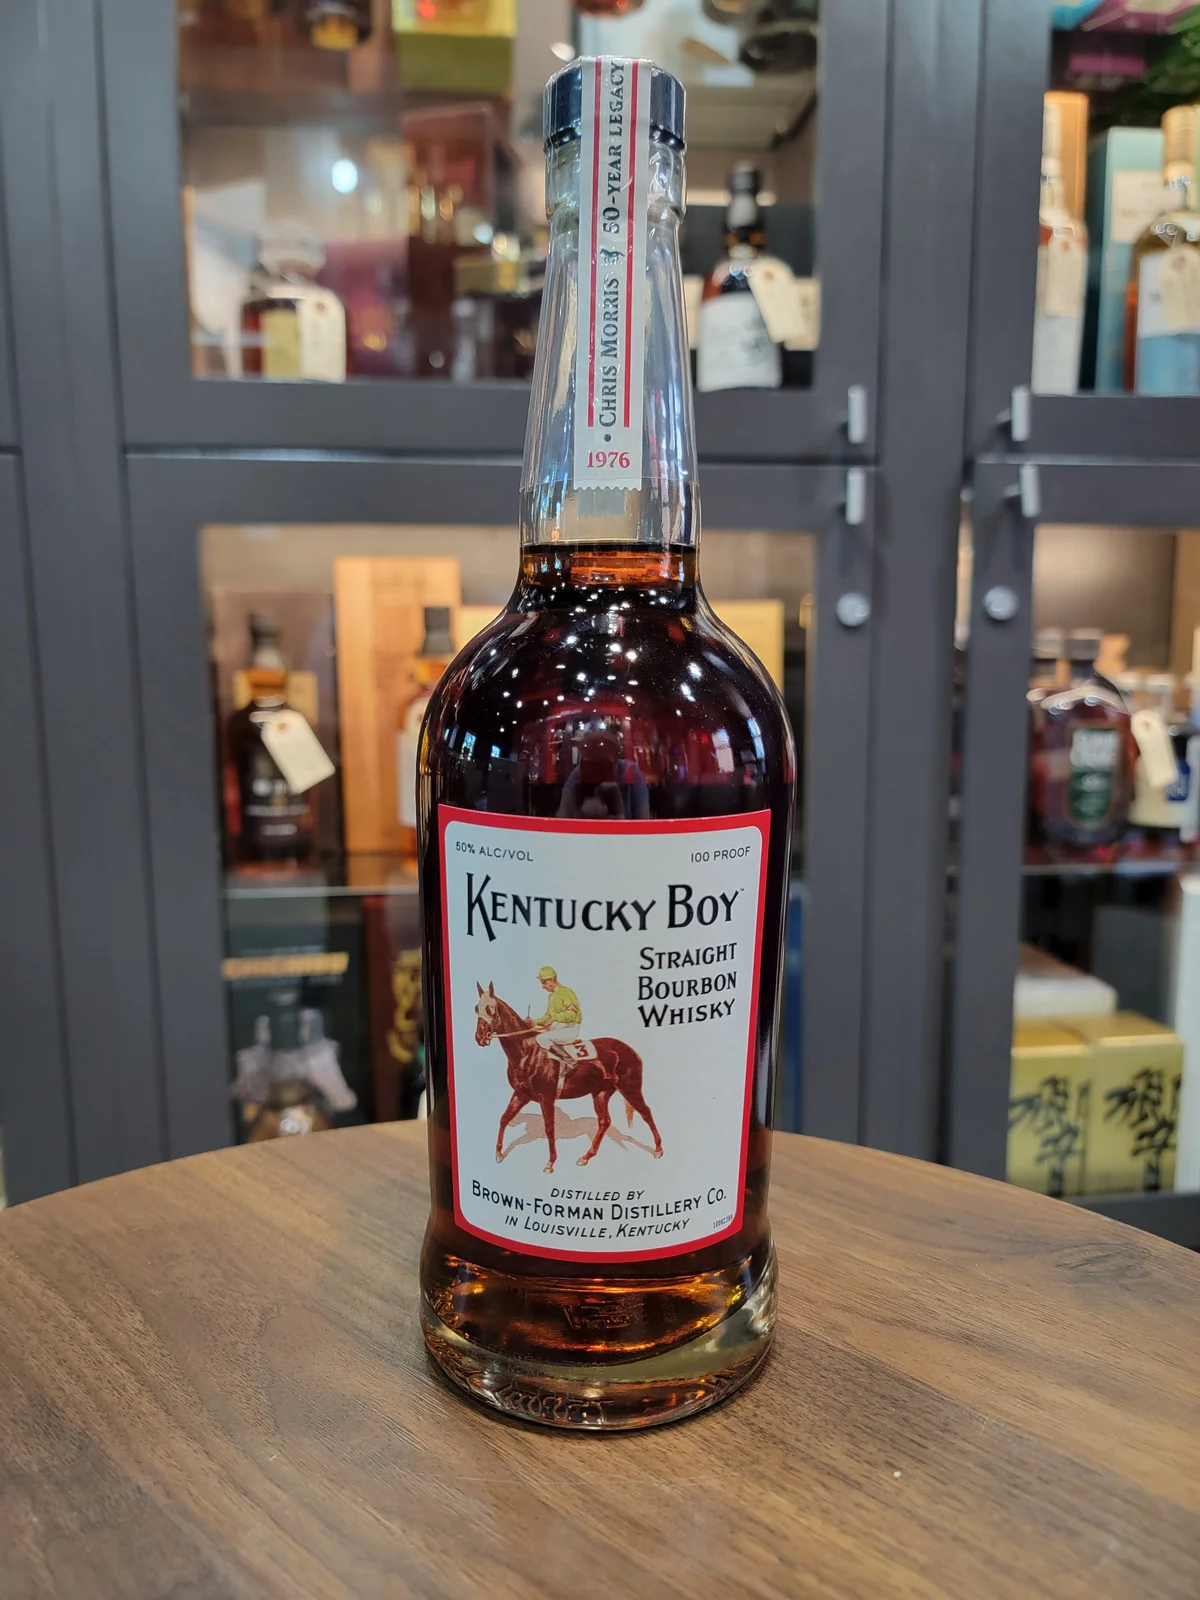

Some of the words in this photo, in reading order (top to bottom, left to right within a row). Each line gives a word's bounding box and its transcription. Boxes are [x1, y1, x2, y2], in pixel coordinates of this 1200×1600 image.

[609, 60, 625, 137] LEGACY
[603, 144, 622, 234] 50-YEAR
[601, 278, 619, 359] MORRIS
[599, 365, 617, 427] CHRIS
[586, 451, 631, 469] 1976
[455, 840, 476, 854] 50%
[479, 846, 534, 862] ALC/VOL
[691, 851, 710, 863] 100
[713, 846, 751, 861] PROOF
[466, 872, 657, 942] KENTUCKY
[639, 942, 737, 970] STRAIGHT
[637, 971, 737, 1001] BOURBON
[637, 998, 735, 1028] WHISKY
[575, 1044, 590, 1058] 3
[472, 1179, 604, 1220] BROWN-FORMAN
[611, 1195, 701, 1220] DISTILLERY
[707, 1187, 727, 1205] CO.
[550, 1188, 621, 1201] DISTILLED
[627, 1189, 645, 1201] BY
[505, 1215, 518, 1227] IN
[524, 1216, 612, 1239] LOUISVILLE,
[616, 1218, 690, 1237] KENTUCKY
